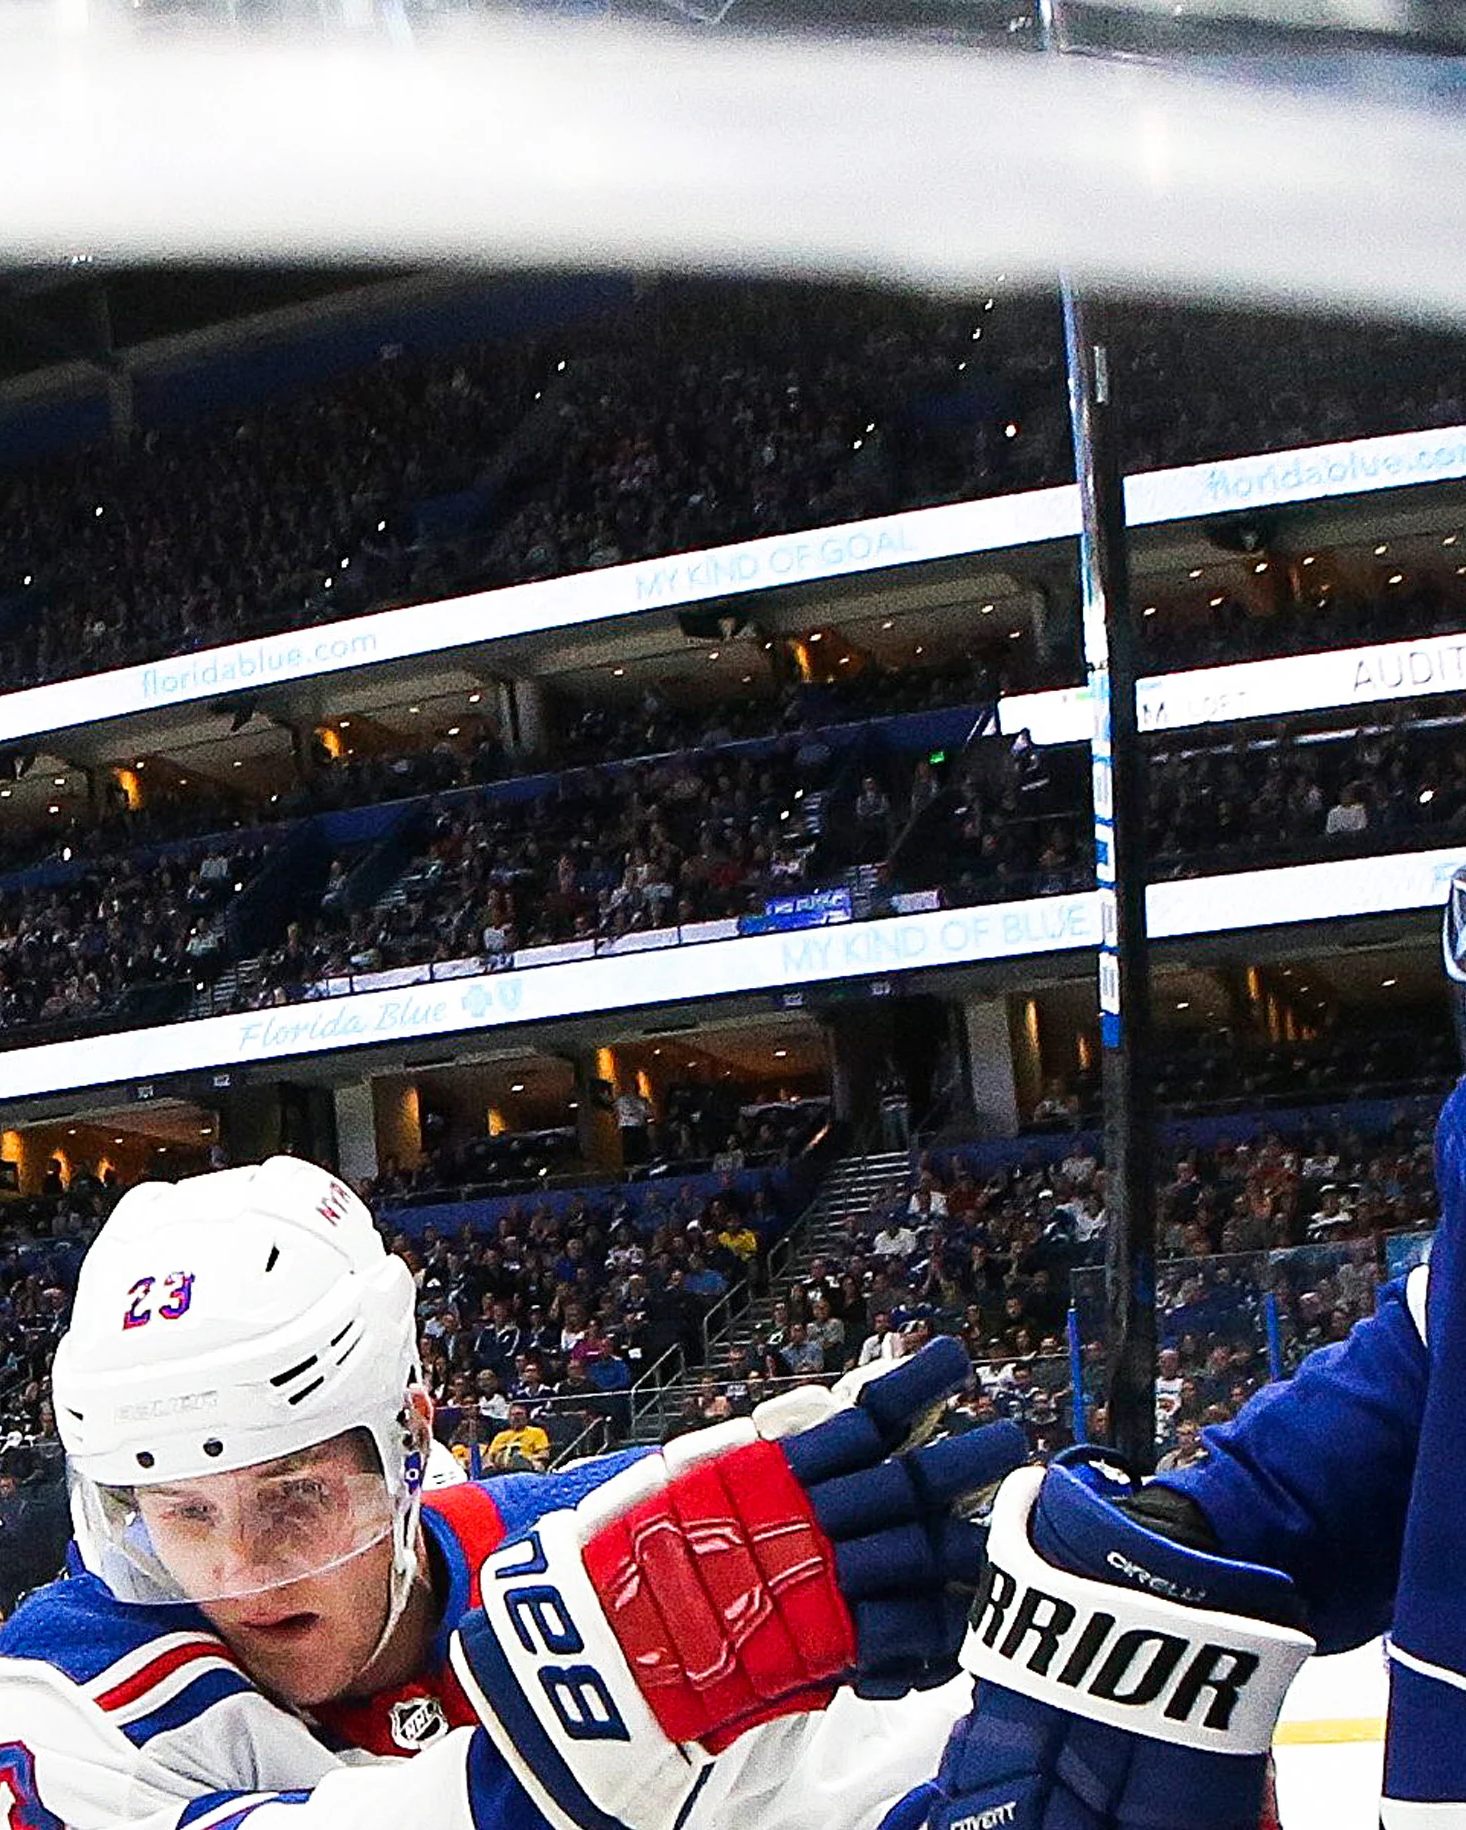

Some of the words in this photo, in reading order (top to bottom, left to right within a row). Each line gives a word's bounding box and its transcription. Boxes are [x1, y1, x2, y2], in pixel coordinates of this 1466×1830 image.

[141, 629, 379, 701] floridablue.com
[1351, 645, 1466, 692] AUDIT
[237, 1007, 369, 1055] Florida
[376, 993, 450, 1034] Blue
[119, 1267, 199, 1334] 23
